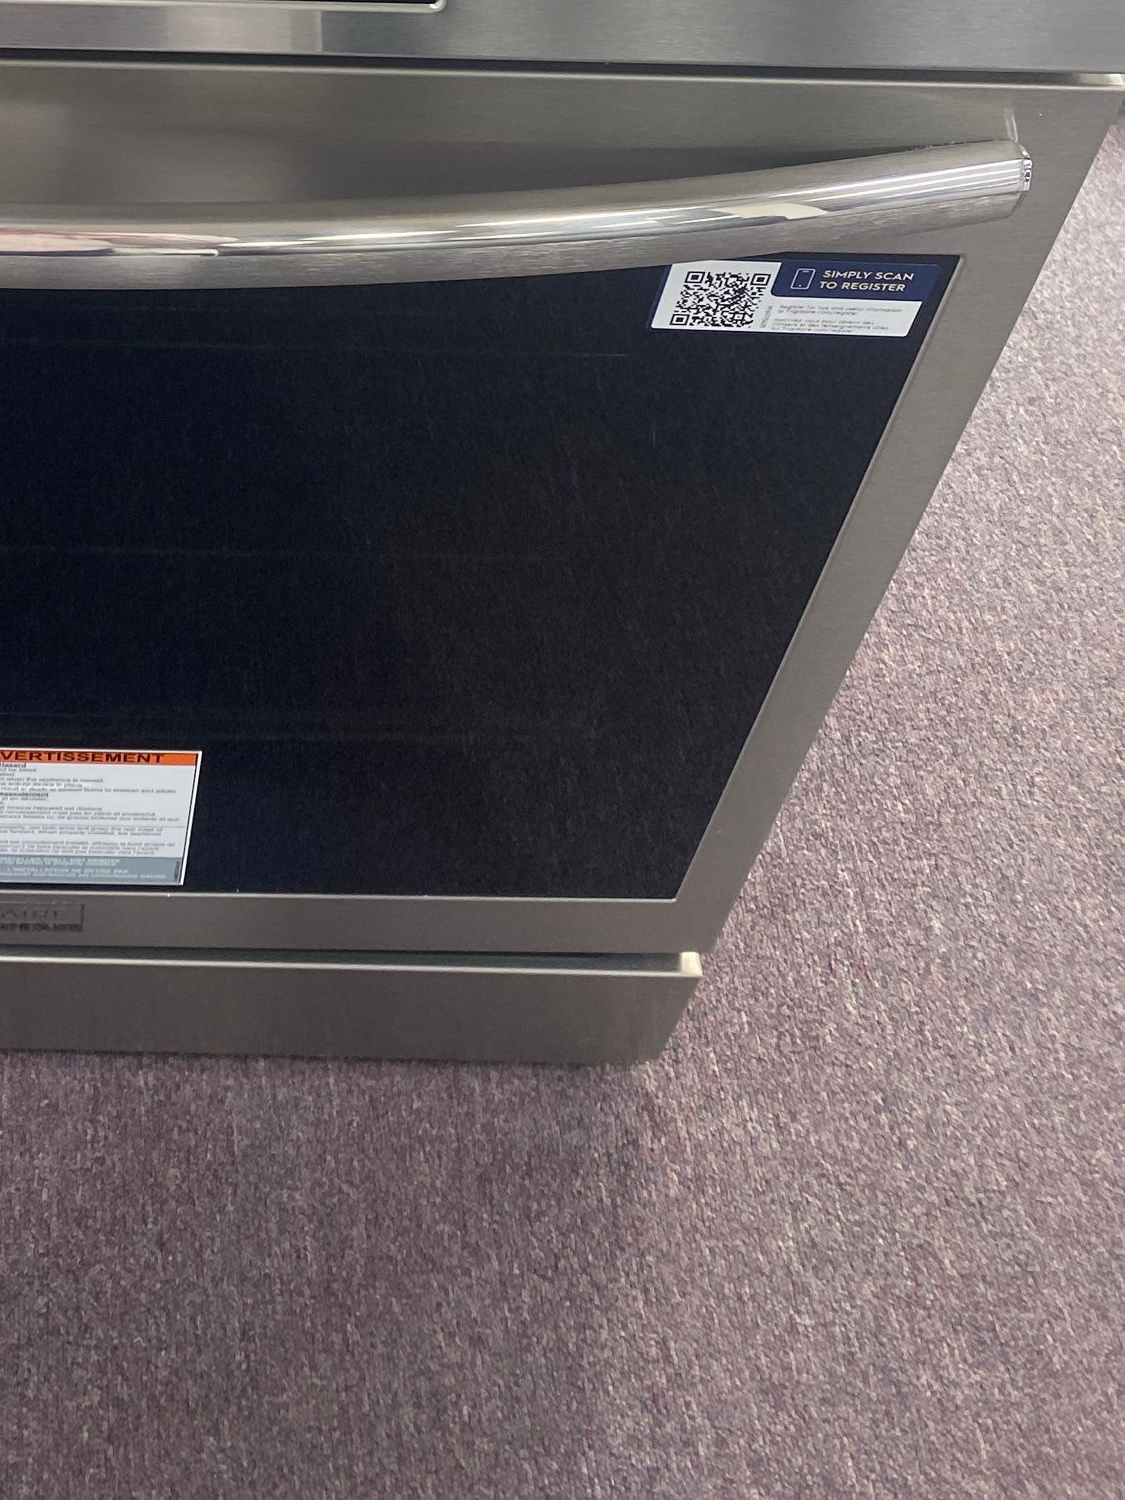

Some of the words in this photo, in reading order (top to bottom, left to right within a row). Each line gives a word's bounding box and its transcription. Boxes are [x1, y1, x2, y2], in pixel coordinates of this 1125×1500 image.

[822, 269, 873, 280] SIMPLY
[874, 271, 915, 281] SCAN
[819, 280, 838, 290] TO
[840, 281, 907, 293] REGISTER
